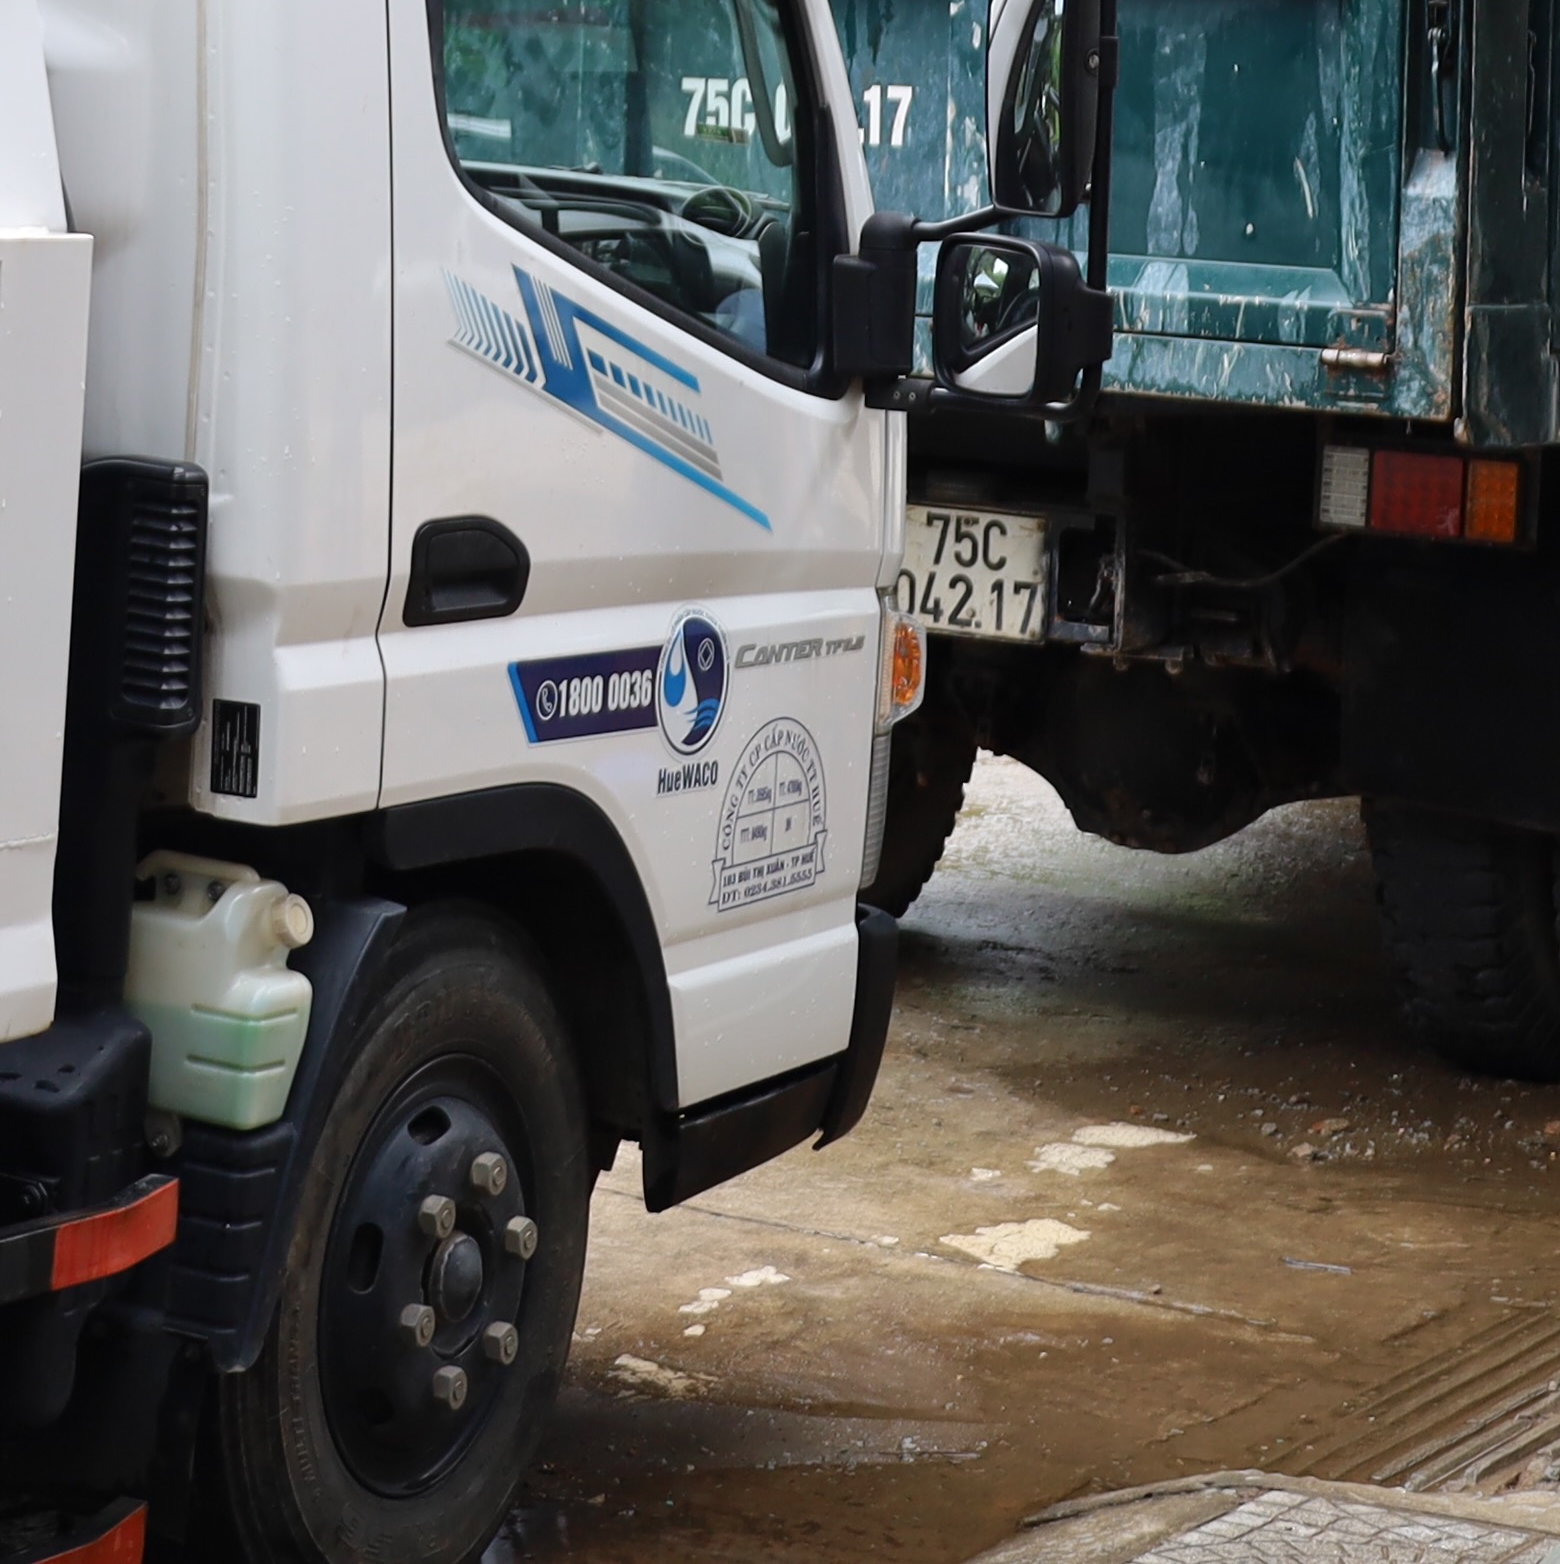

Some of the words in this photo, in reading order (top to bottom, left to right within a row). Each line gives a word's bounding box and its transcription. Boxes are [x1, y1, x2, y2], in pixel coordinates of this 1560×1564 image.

[926, 511, 1007, 571] 75C
[896, 568, 1039, 635] 042.17
[735, 637, 823, 669] CANTER
[557, 674, 603, 717] 1800
[607, 668, 652, 709] 0036
[657, 761, 718, 794] HueWACO
[736, 764, 748, 789] TY
[749, 743, 761, 767] CP
